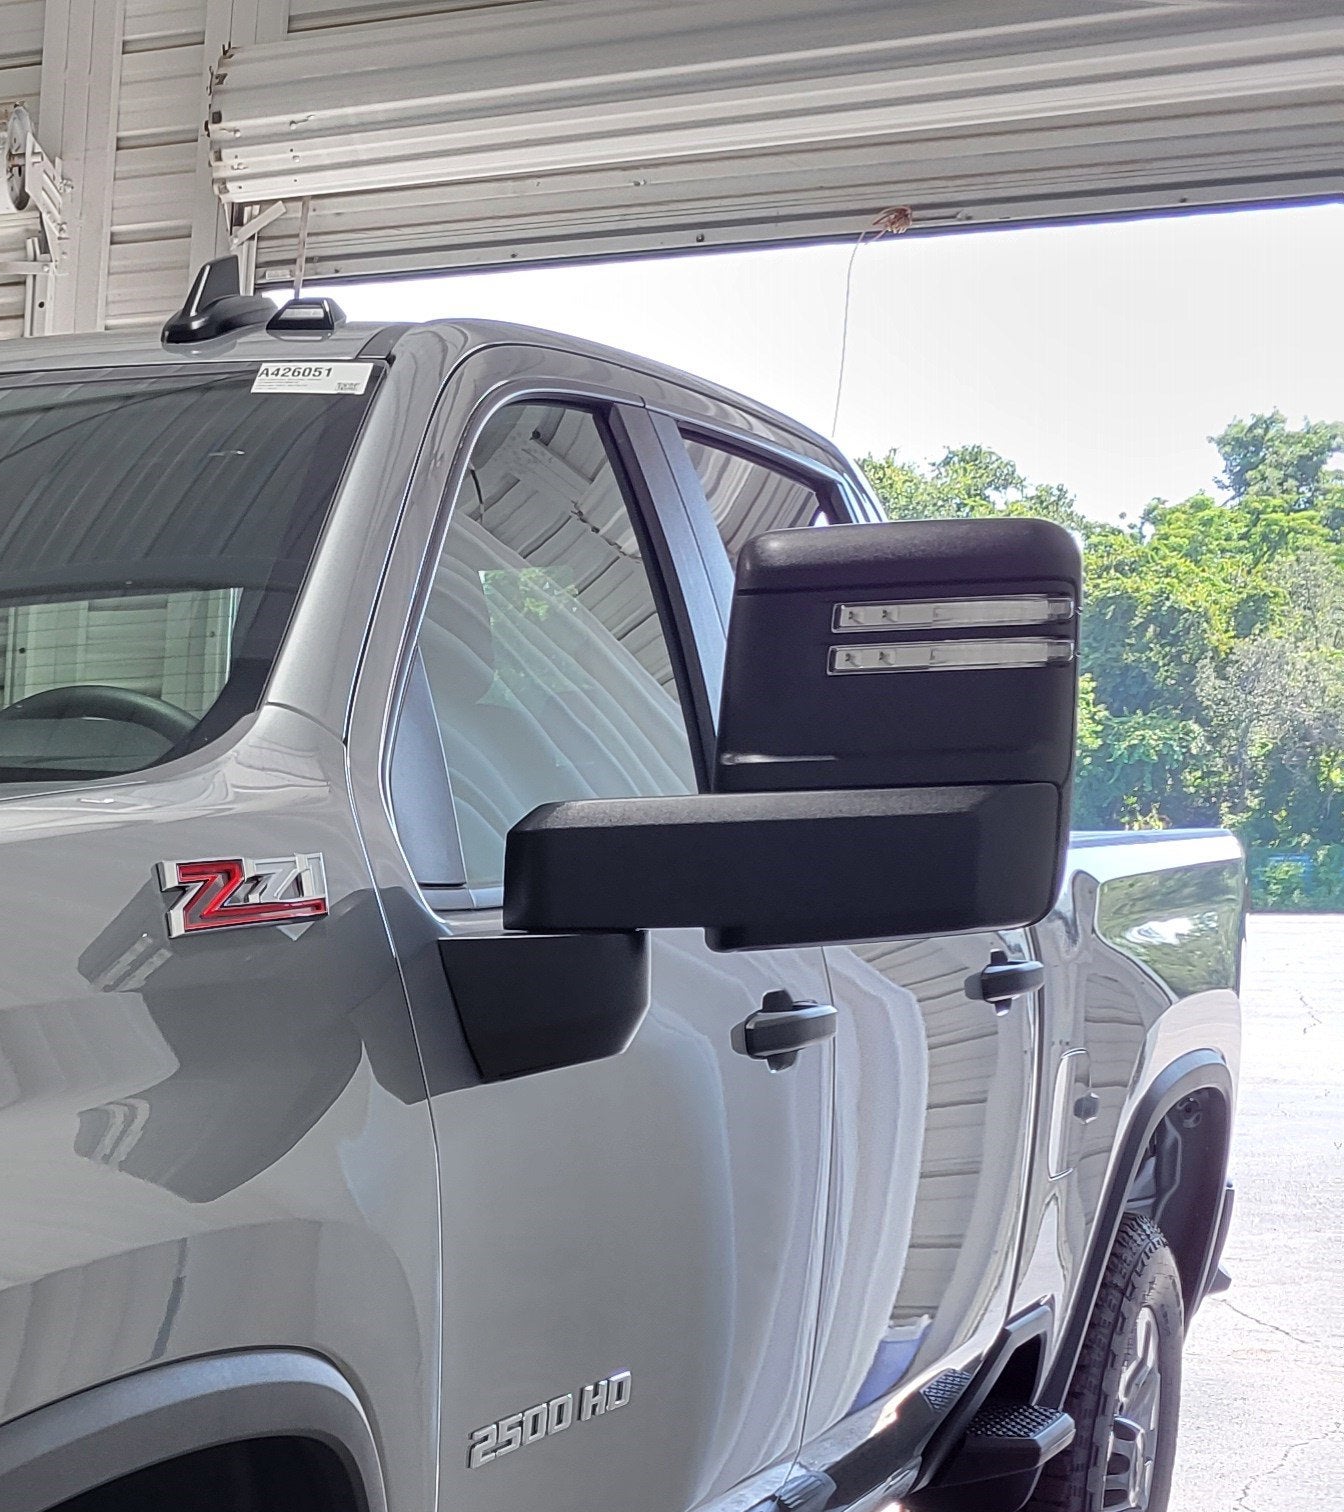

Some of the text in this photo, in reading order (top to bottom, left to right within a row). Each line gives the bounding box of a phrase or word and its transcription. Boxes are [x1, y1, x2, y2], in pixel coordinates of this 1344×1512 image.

[257, 366, 333, 378] A426051
[158, 853, 329, 938] Z71
[467, 1368, 632, 1469] 2500 HD
